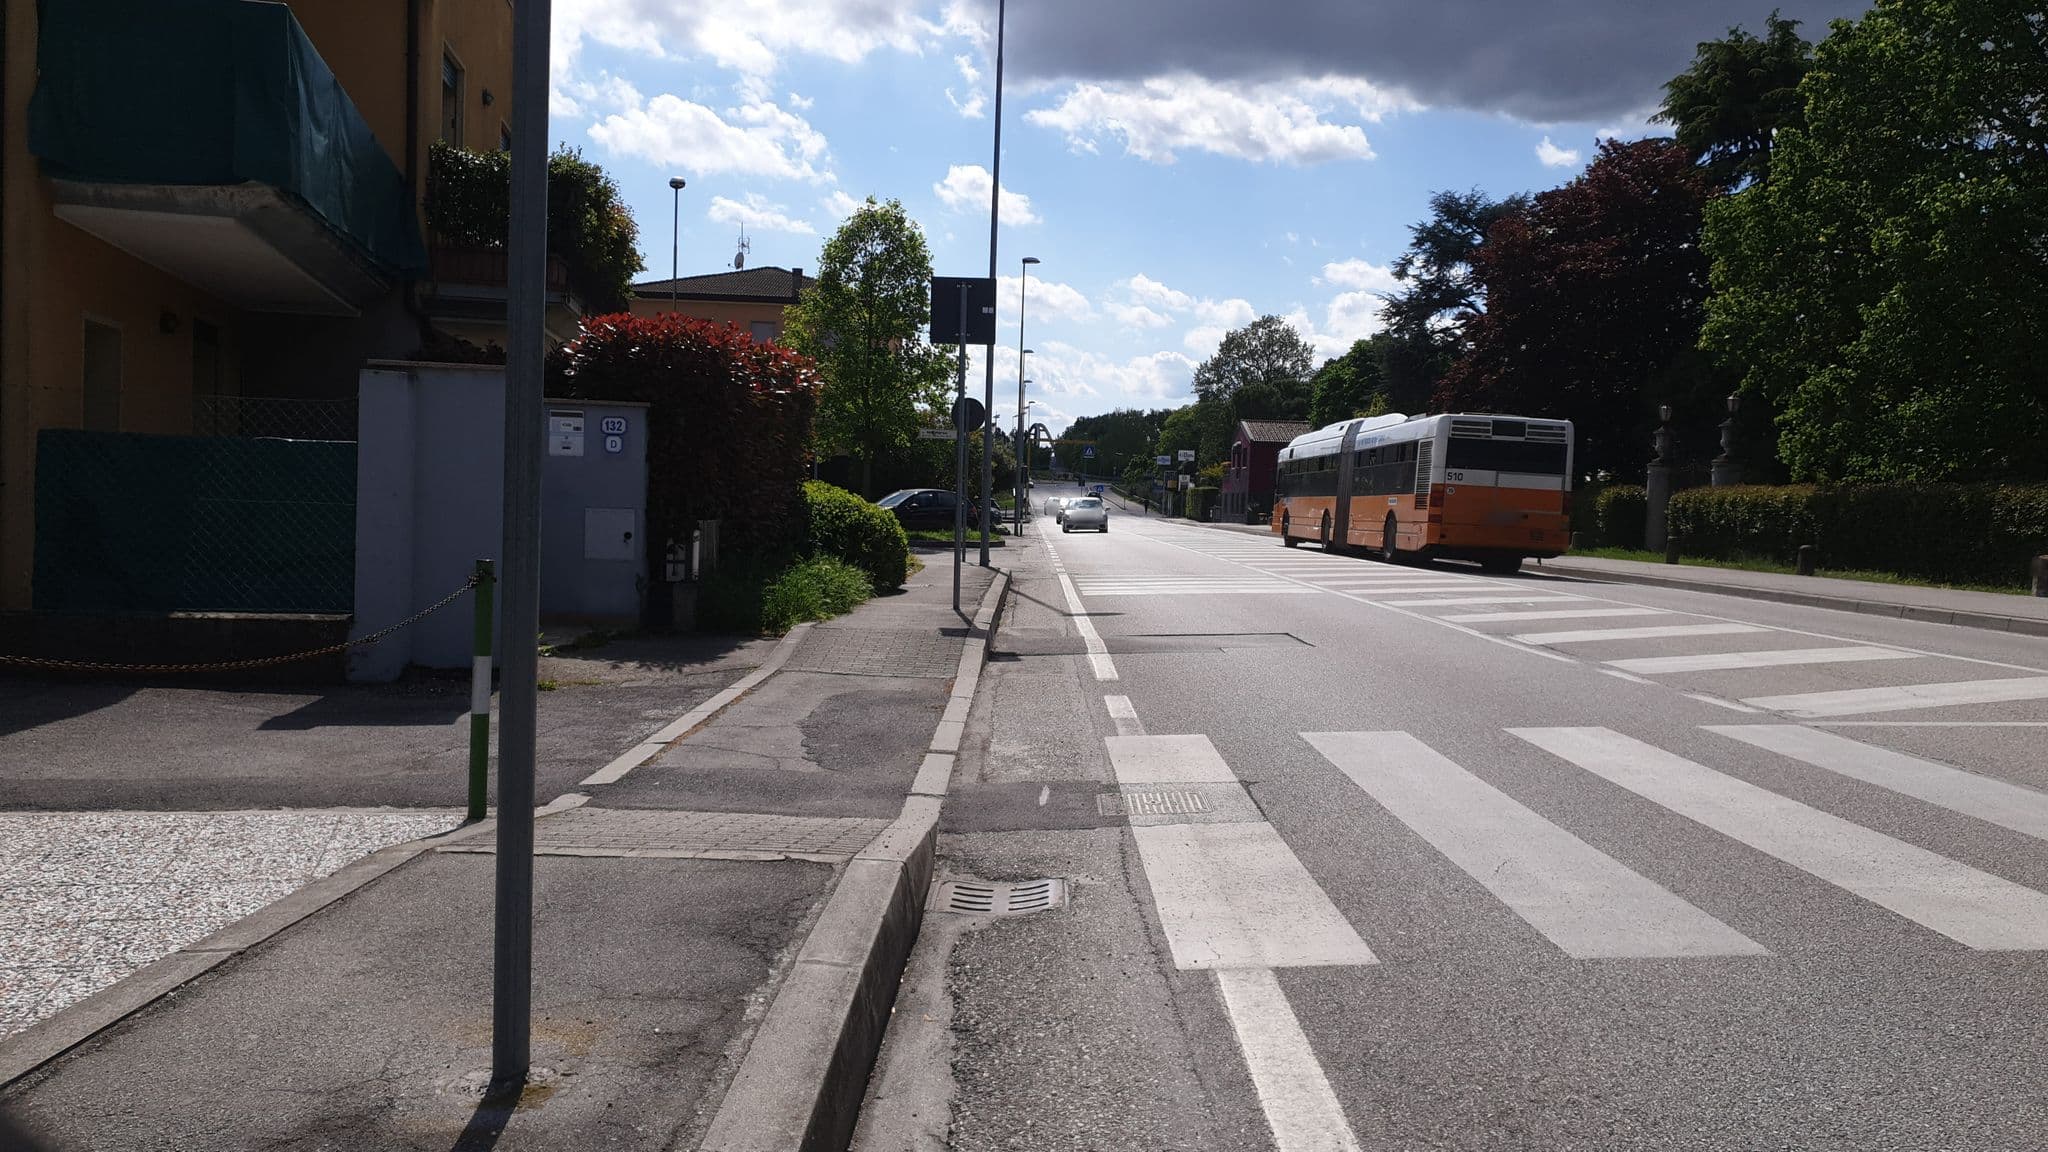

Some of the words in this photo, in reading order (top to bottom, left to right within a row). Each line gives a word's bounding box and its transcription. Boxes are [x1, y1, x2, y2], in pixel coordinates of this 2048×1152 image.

[605, 420, 622, 431] 132
[611, 440, 617, 448] D
[1447, 472, 1463, 481] 510
